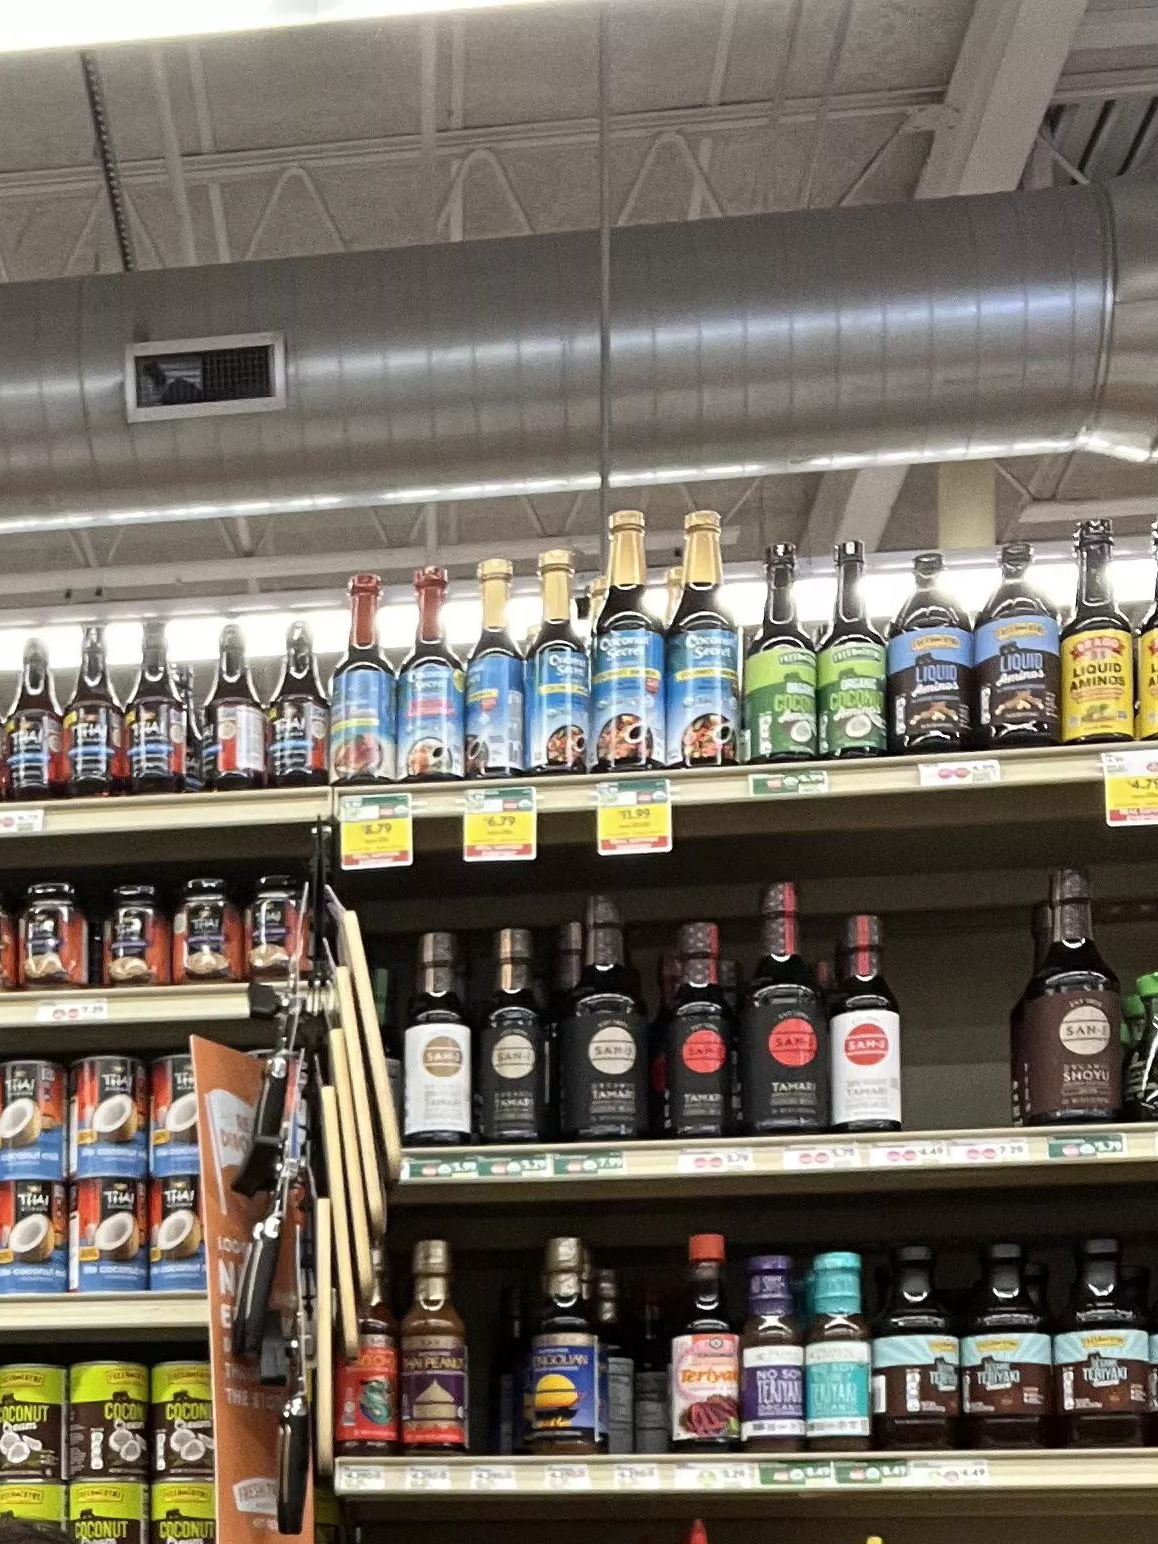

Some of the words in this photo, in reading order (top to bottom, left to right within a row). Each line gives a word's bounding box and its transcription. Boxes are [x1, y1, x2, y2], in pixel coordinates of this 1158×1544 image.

[999, 652, 1043, 672] LIQUID
[914, 665, 958, 683] LIQUID
[1072, 665, 1122, 677] LIQUID
[1069, 676, 1125, 691] AMINOS
[848, 1041, 885, 1051] SAN-J
[1063, 1070, 1110, 1081] SHOYU
[757, 1370, 778, 1380] NO
[75, 1521, 128, 1538] COCONUT
[160, 1521, 215, 1538] COCONUT
